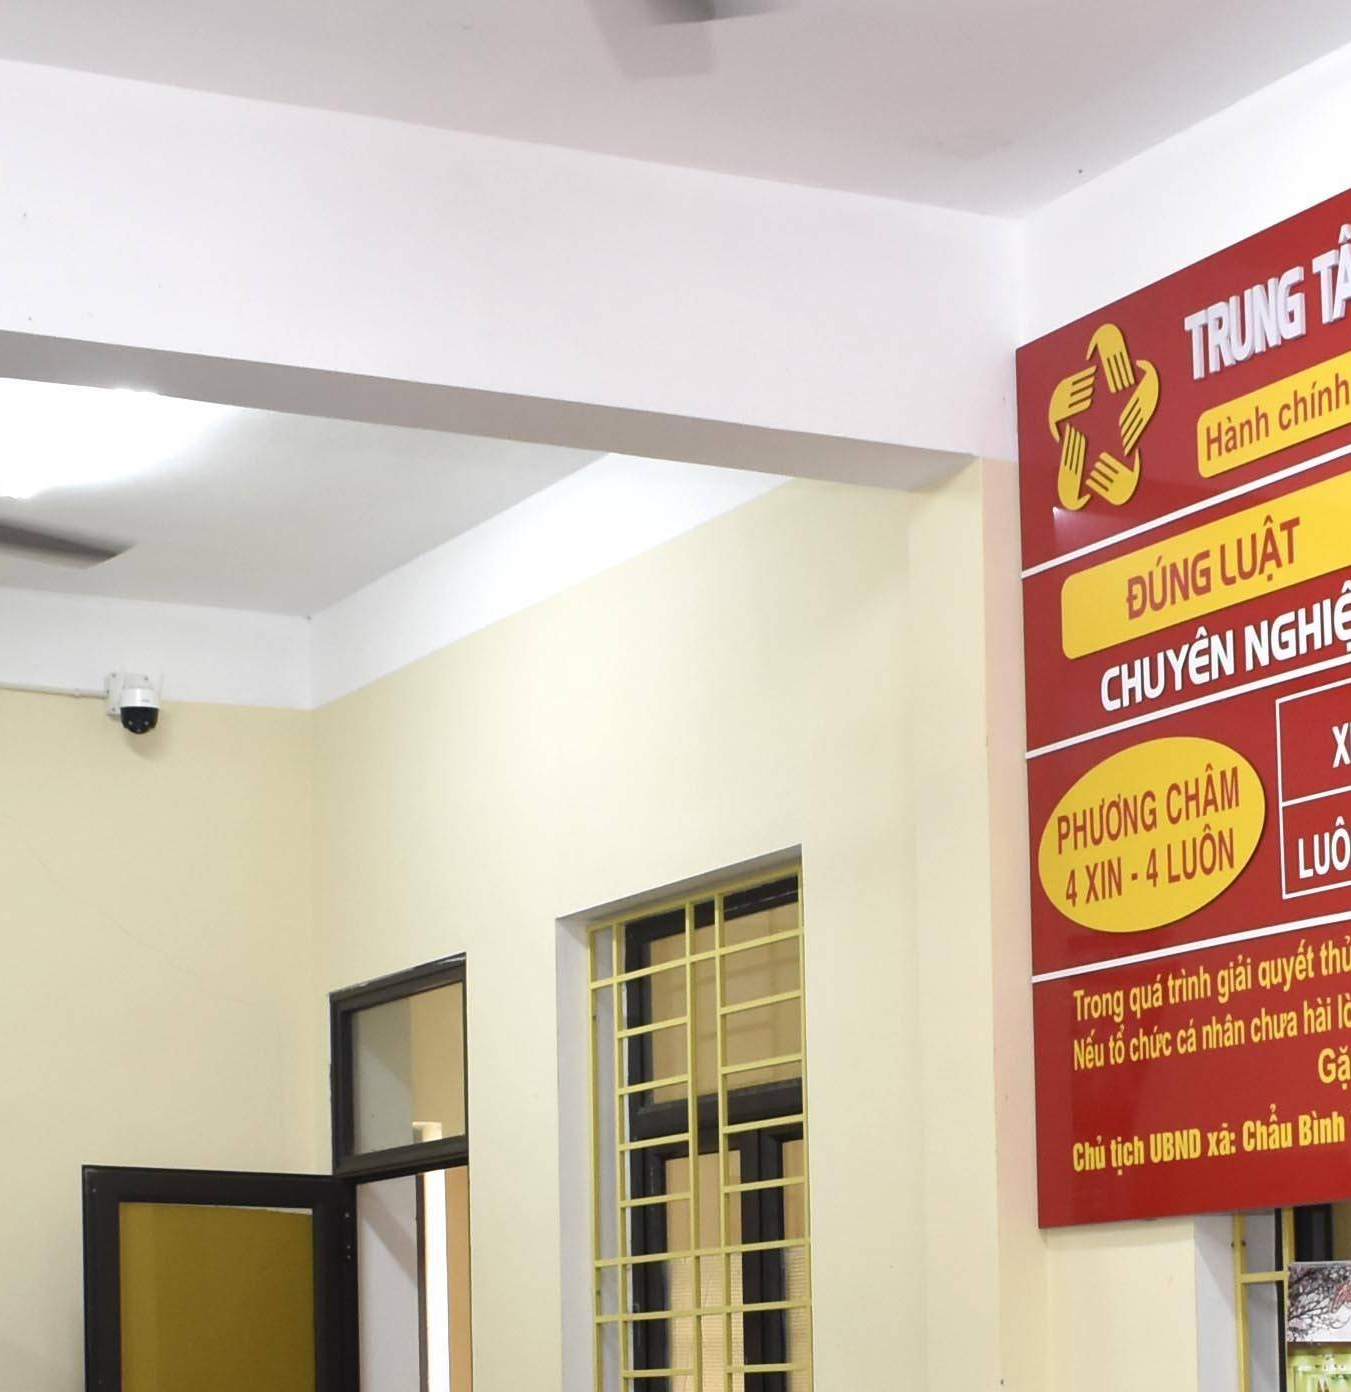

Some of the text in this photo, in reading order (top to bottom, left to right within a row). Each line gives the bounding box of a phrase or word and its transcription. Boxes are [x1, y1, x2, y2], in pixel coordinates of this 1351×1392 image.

[1184, 266, 1306, 380] TRUNG
[1205, 405, 1270, 461] Hành
[1278, 373, 1350, 431] chính
[1125, 514, 1301, 620] ĐÚNG LUẬT
[1101, 626, 1235, 711] CHUYÊN
[1056, 762, 1240, 856] PHƯƠNG CHÂM
[1065, 823, 1235, 907] 4 XIN - 4 LUÔN
[1073, 990, 1124, 1023] Trong
[1130, 975, 1162, 1018] quá
[1167, 966, 1211, 1004] trình
[1217, 955, 1252, 1003] giải
[1258, 939, 1314, 992] quyết
[1073, 1136, 1105, 1171] Chủ
[1110, 1136, 1144, 1175] tịch
[1150, 1128, 1201, 1163] UBND
[1207, 1123, 1236, 1156] xã:
[1242, 1104, 1292, 1151] Chẩu
[1298, 1111, 1345, 1146] Bình
